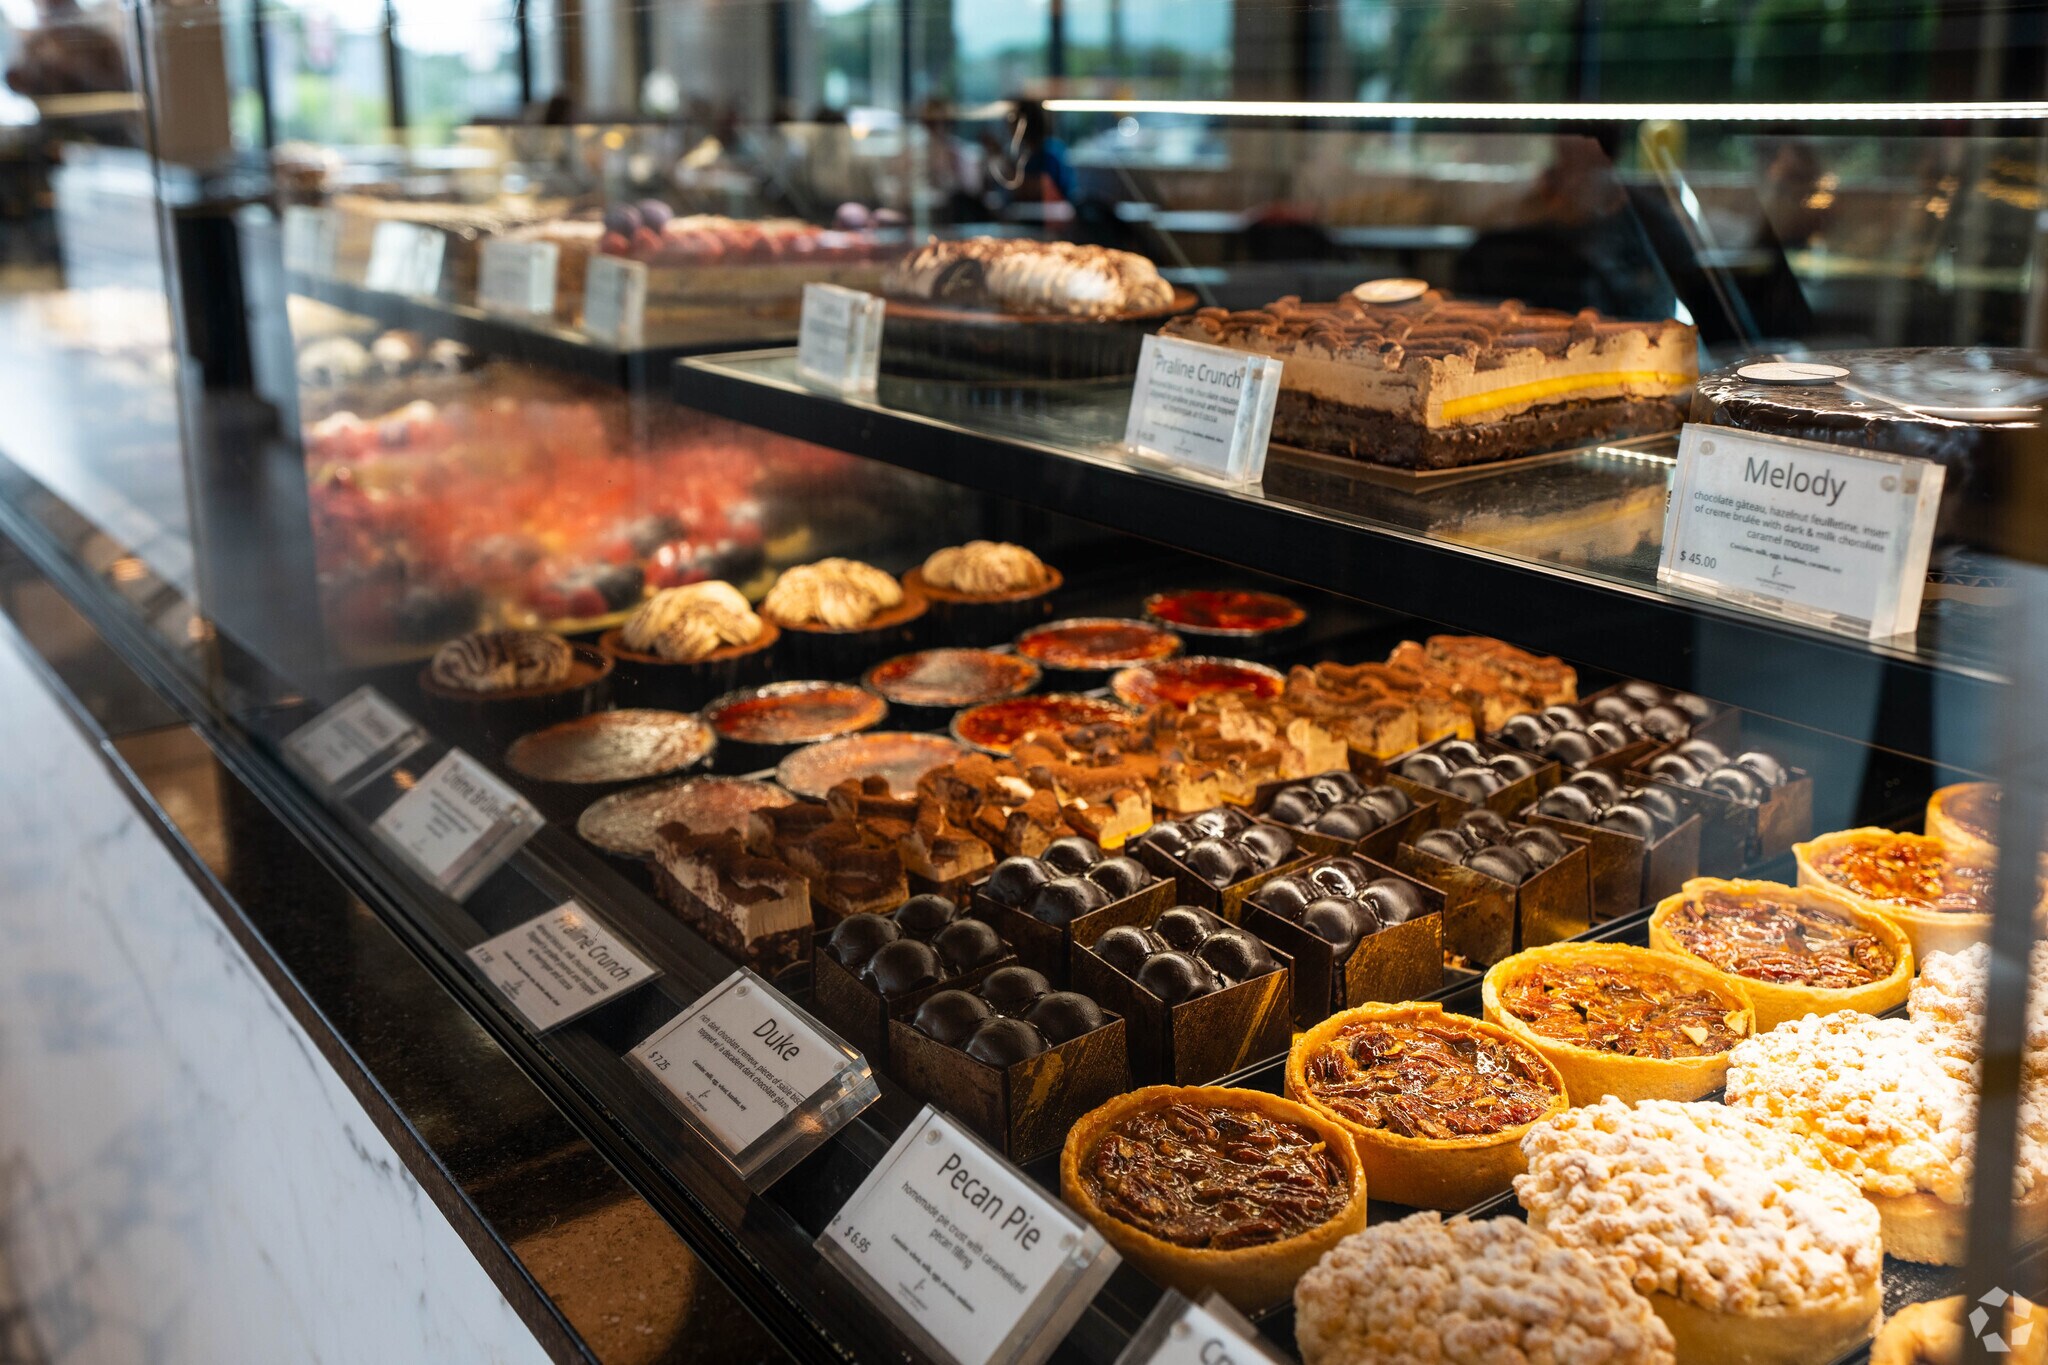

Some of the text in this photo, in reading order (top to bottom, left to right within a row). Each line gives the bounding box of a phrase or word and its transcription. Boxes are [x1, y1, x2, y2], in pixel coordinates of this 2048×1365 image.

[1197, 363, 1242, 389] Crunch
[1745, 457, 1846, 506] Melody
[1694, 491, 1734, 507] chocolate
[1769, 506, 1809, 522] hazelnut
[1694, 504, 1704, 513] of
[1762, 519, 1782, 530] with
[1783, 524, 1804, 535] dark
[1806, 527, 1814, 537] &
[1815, 531, 1836, 542] milk
[1837, 535, 1884, 552] chocolate
[1746, 530, 1820, 553] caramel mousse
[1679, 550, 1716, 569] $ 45.00
[587, 945, 631, 981] Crunch
[699, 1014, 711, 1024] rich
[707, 1021, 720, 1033] dark
[717, 1030, 740, 1050] chocolate
[753, 1018, 799, 1061] Duke
[648, 1051, 670, 1071] $ 7.25
[697, 1027, 717, 1044] topped
[712, 1040, 724, 1049] w/
[721, 1049, 745, 1070] decadent
[741, 1067, 755, 1079] dark
[752, 1076, 776, 1098] chocolate
[754, 1065, 774, 1080] pieces
[771, 1077, 782, 1085] of
[776, 1082, 792, 1096] sable
[937, 1153, 1040, 1250] Pecan Pie
[843, 1226, 871, 1253] $ 6.95
[901, 1181, 1027, 1293] homemade pie crust with caramelized
[929, 1228, 972, 1270] pecan filling
